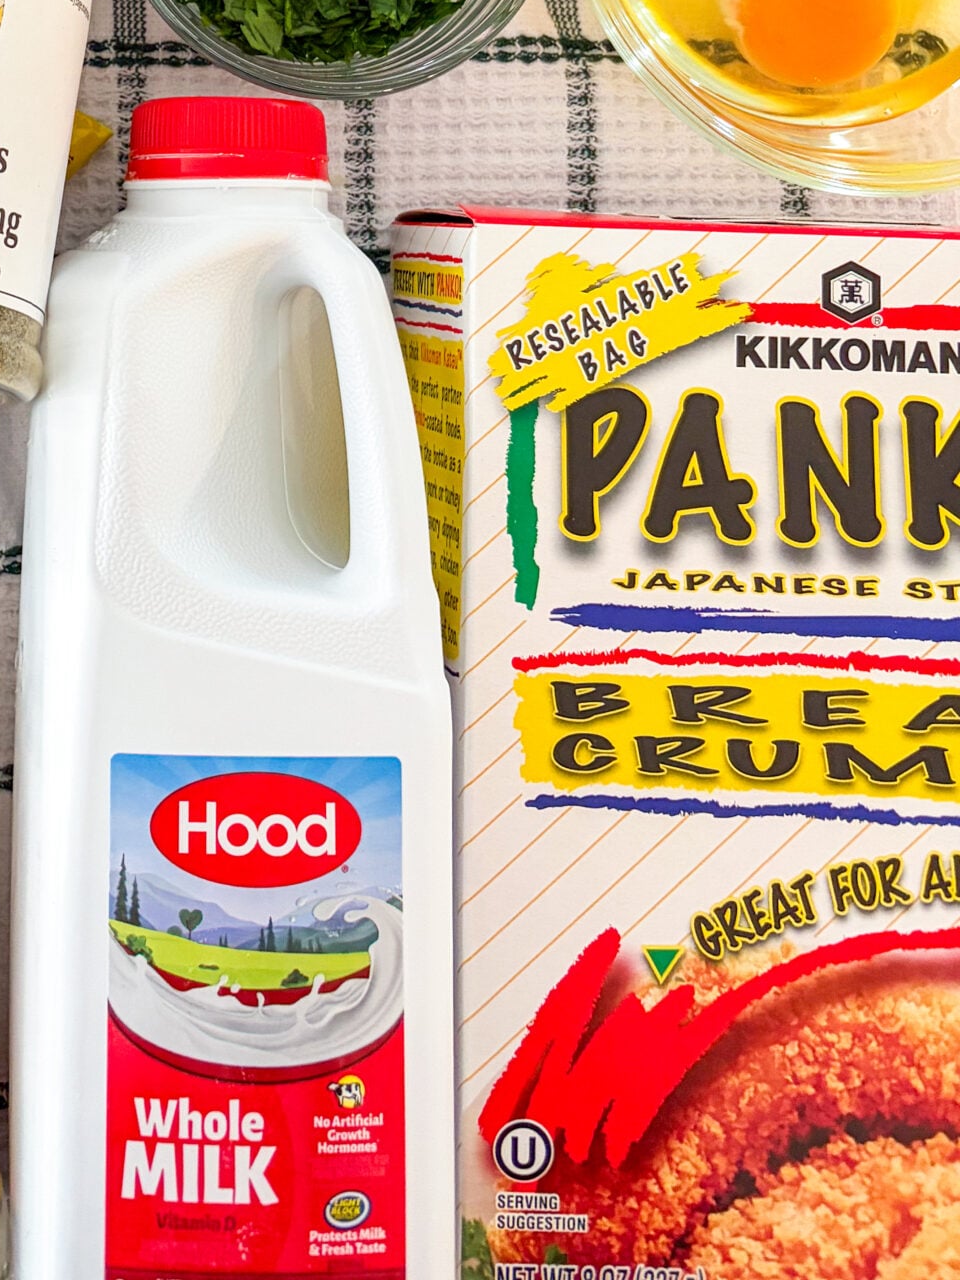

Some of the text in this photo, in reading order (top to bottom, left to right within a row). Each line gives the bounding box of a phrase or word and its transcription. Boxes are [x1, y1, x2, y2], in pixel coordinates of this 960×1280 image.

[417, 271, 435, 297] WITH
[436, 271, 462, 300] PANKO!
[506, 263, 689, 370] RESEALABLE
[578, 329, 647, 381] BAG
[421, 375, 462, 410] perfect partner
[613, 570, 878, 598] JAPANESE
[178, 800, 337, 858] Hood
[693, 857, 910, 957] GREAT FOR
[133, 1096, 264, 1142] Whole
[313, 1112, 384, 1128] No Artificial
[317, 1141, 377, 1154] Hormones
[327, 1127, 370, 1141] Growth
[121, 1139, 279, 1206] MILK
[497, 1194, 558, 1210] SERVING
[156, 1211, 237, 1231] Vitamin D
[309, 1226, 386, 1242] Protects Milk
[497, 1215, 586, 1231] SUGGESTION
[308, 1241, 386, 1256] & Fresh Taste
